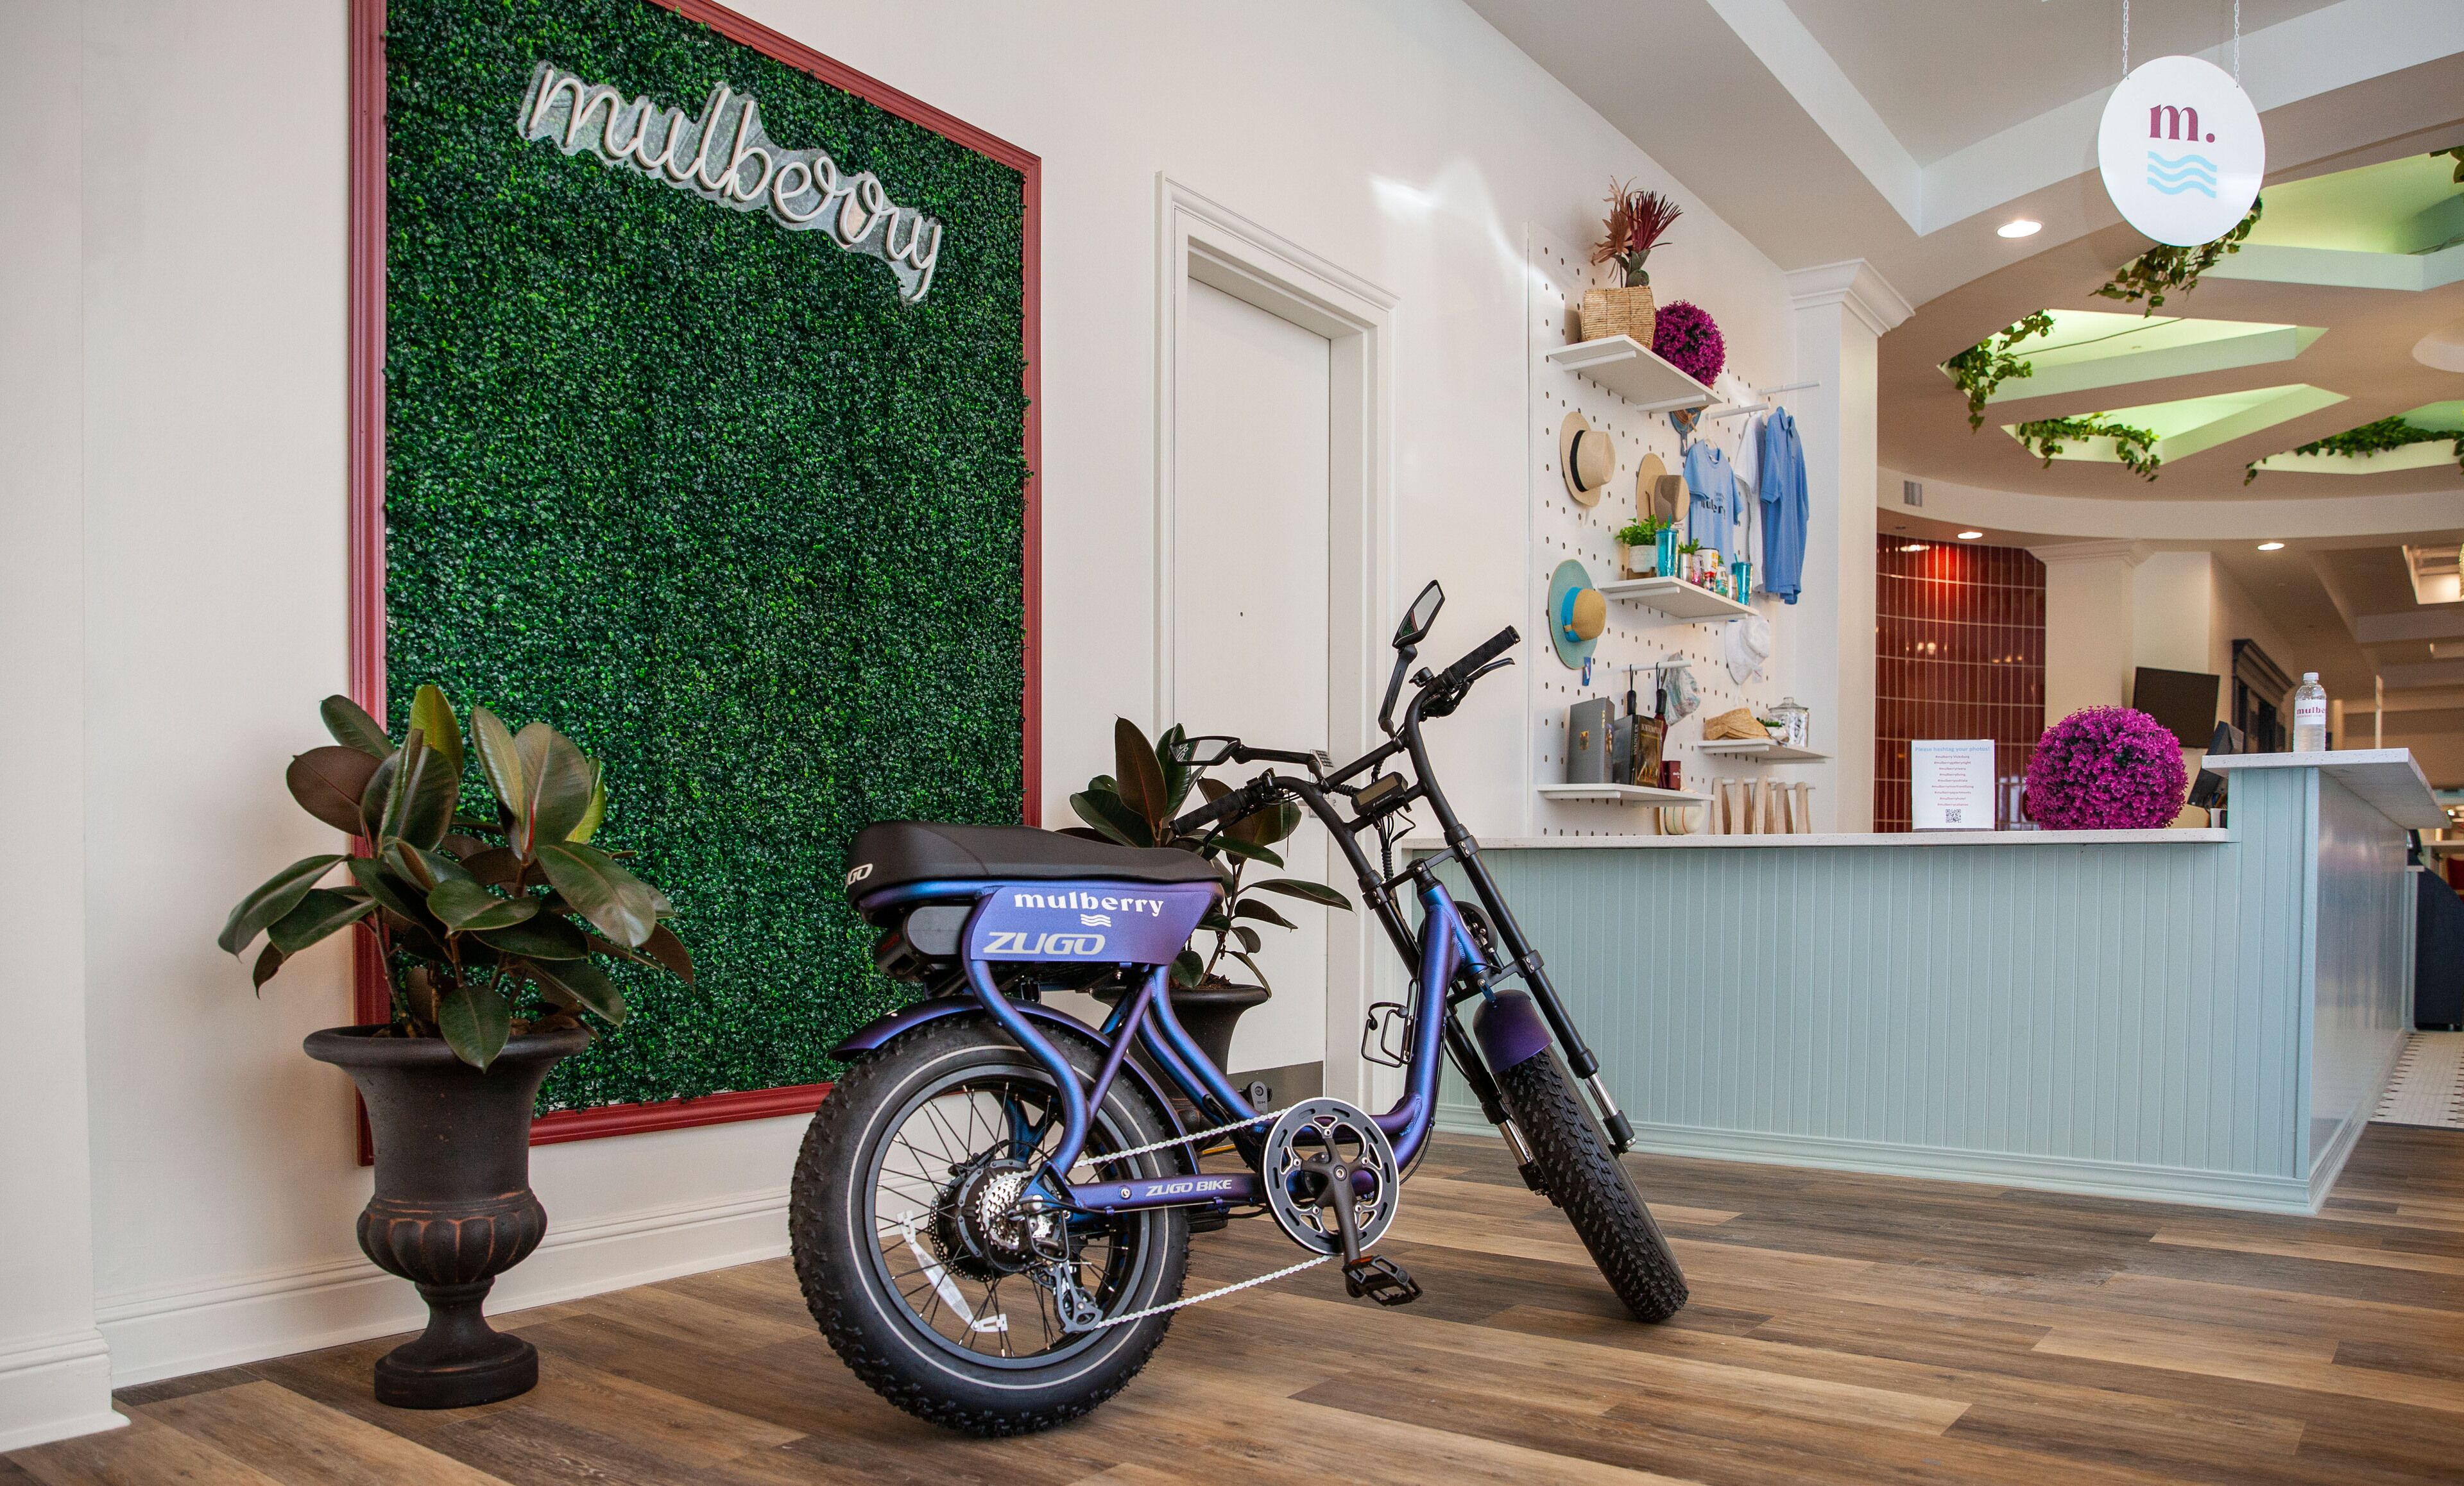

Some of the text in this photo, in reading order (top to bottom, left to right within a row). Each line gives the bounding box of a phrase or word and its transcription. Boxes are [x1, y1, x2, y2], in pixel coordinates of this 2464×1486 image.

[2149, 103, 2216, 144] m.
[528, 69, 942, 302] mulberry
[846, 863, 873, 887] GO
[1014, 891, 1164, 918] mulberry
[982, 932, 1106, 955] ZUGO
[1145, 1179, 1233, 1197] ZUGO BIKE
